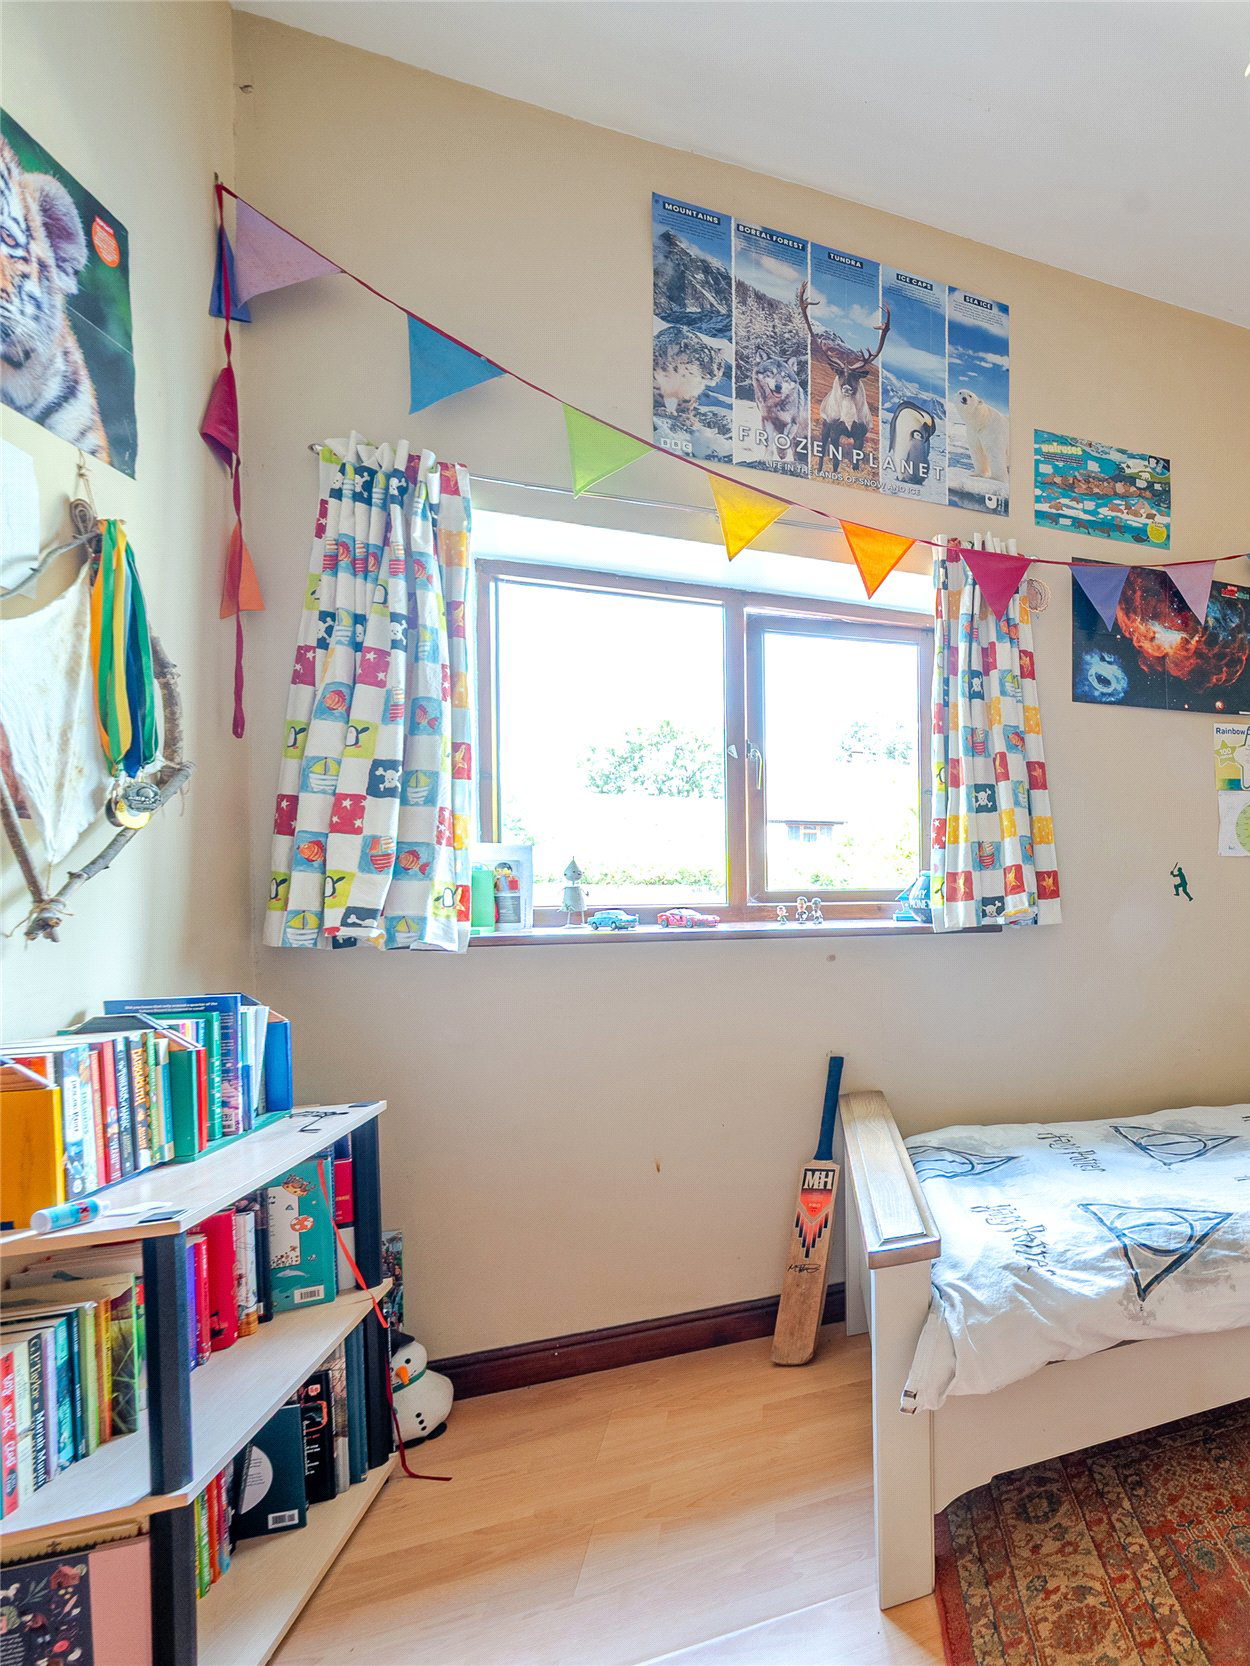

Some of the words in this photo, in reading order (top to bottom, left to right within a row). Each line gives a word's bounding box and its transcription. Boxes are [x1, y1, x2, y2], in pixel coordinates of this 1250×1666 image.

[665, 202, 719, 224] MOUNTAINS
[738, 224, 771, 240] BOREAL
[772, 235, 804, 250] FOREST
[829, 252, 862, 268] TUNDRA
[897, 274, 911, 283] ICE
[911, 279, 932, 290] CAPS
[965, 296, 979, 305] SEA
[979, 301, 992, 310] ICE
[662, 438, 692, 451] BBC
[738, 426, 843, 461] FROZEN
[852, 449, 945, 481] PLANET
[765, 460, 783, 470] LIFE
[784, 463, 794, 472] IN
[795, 465, 813, 475] THE
[815, 470, 843, 481] LANDS
[846, 475, 857, 484] OF
[858, 477, 887, 490] SNOW
[887, 484, 906, 494] AND
[907, 487, 921, 496] ICE
[1215, 727, 1246, 735] Rainbow
[130, 1047, 146, 1107] DARKMOUTH
[1056, 1149, 1107, 1172] Potter
[34, 1410, 47, 1449] Mariah
[36, 1449, 49, 1488] Mundi
